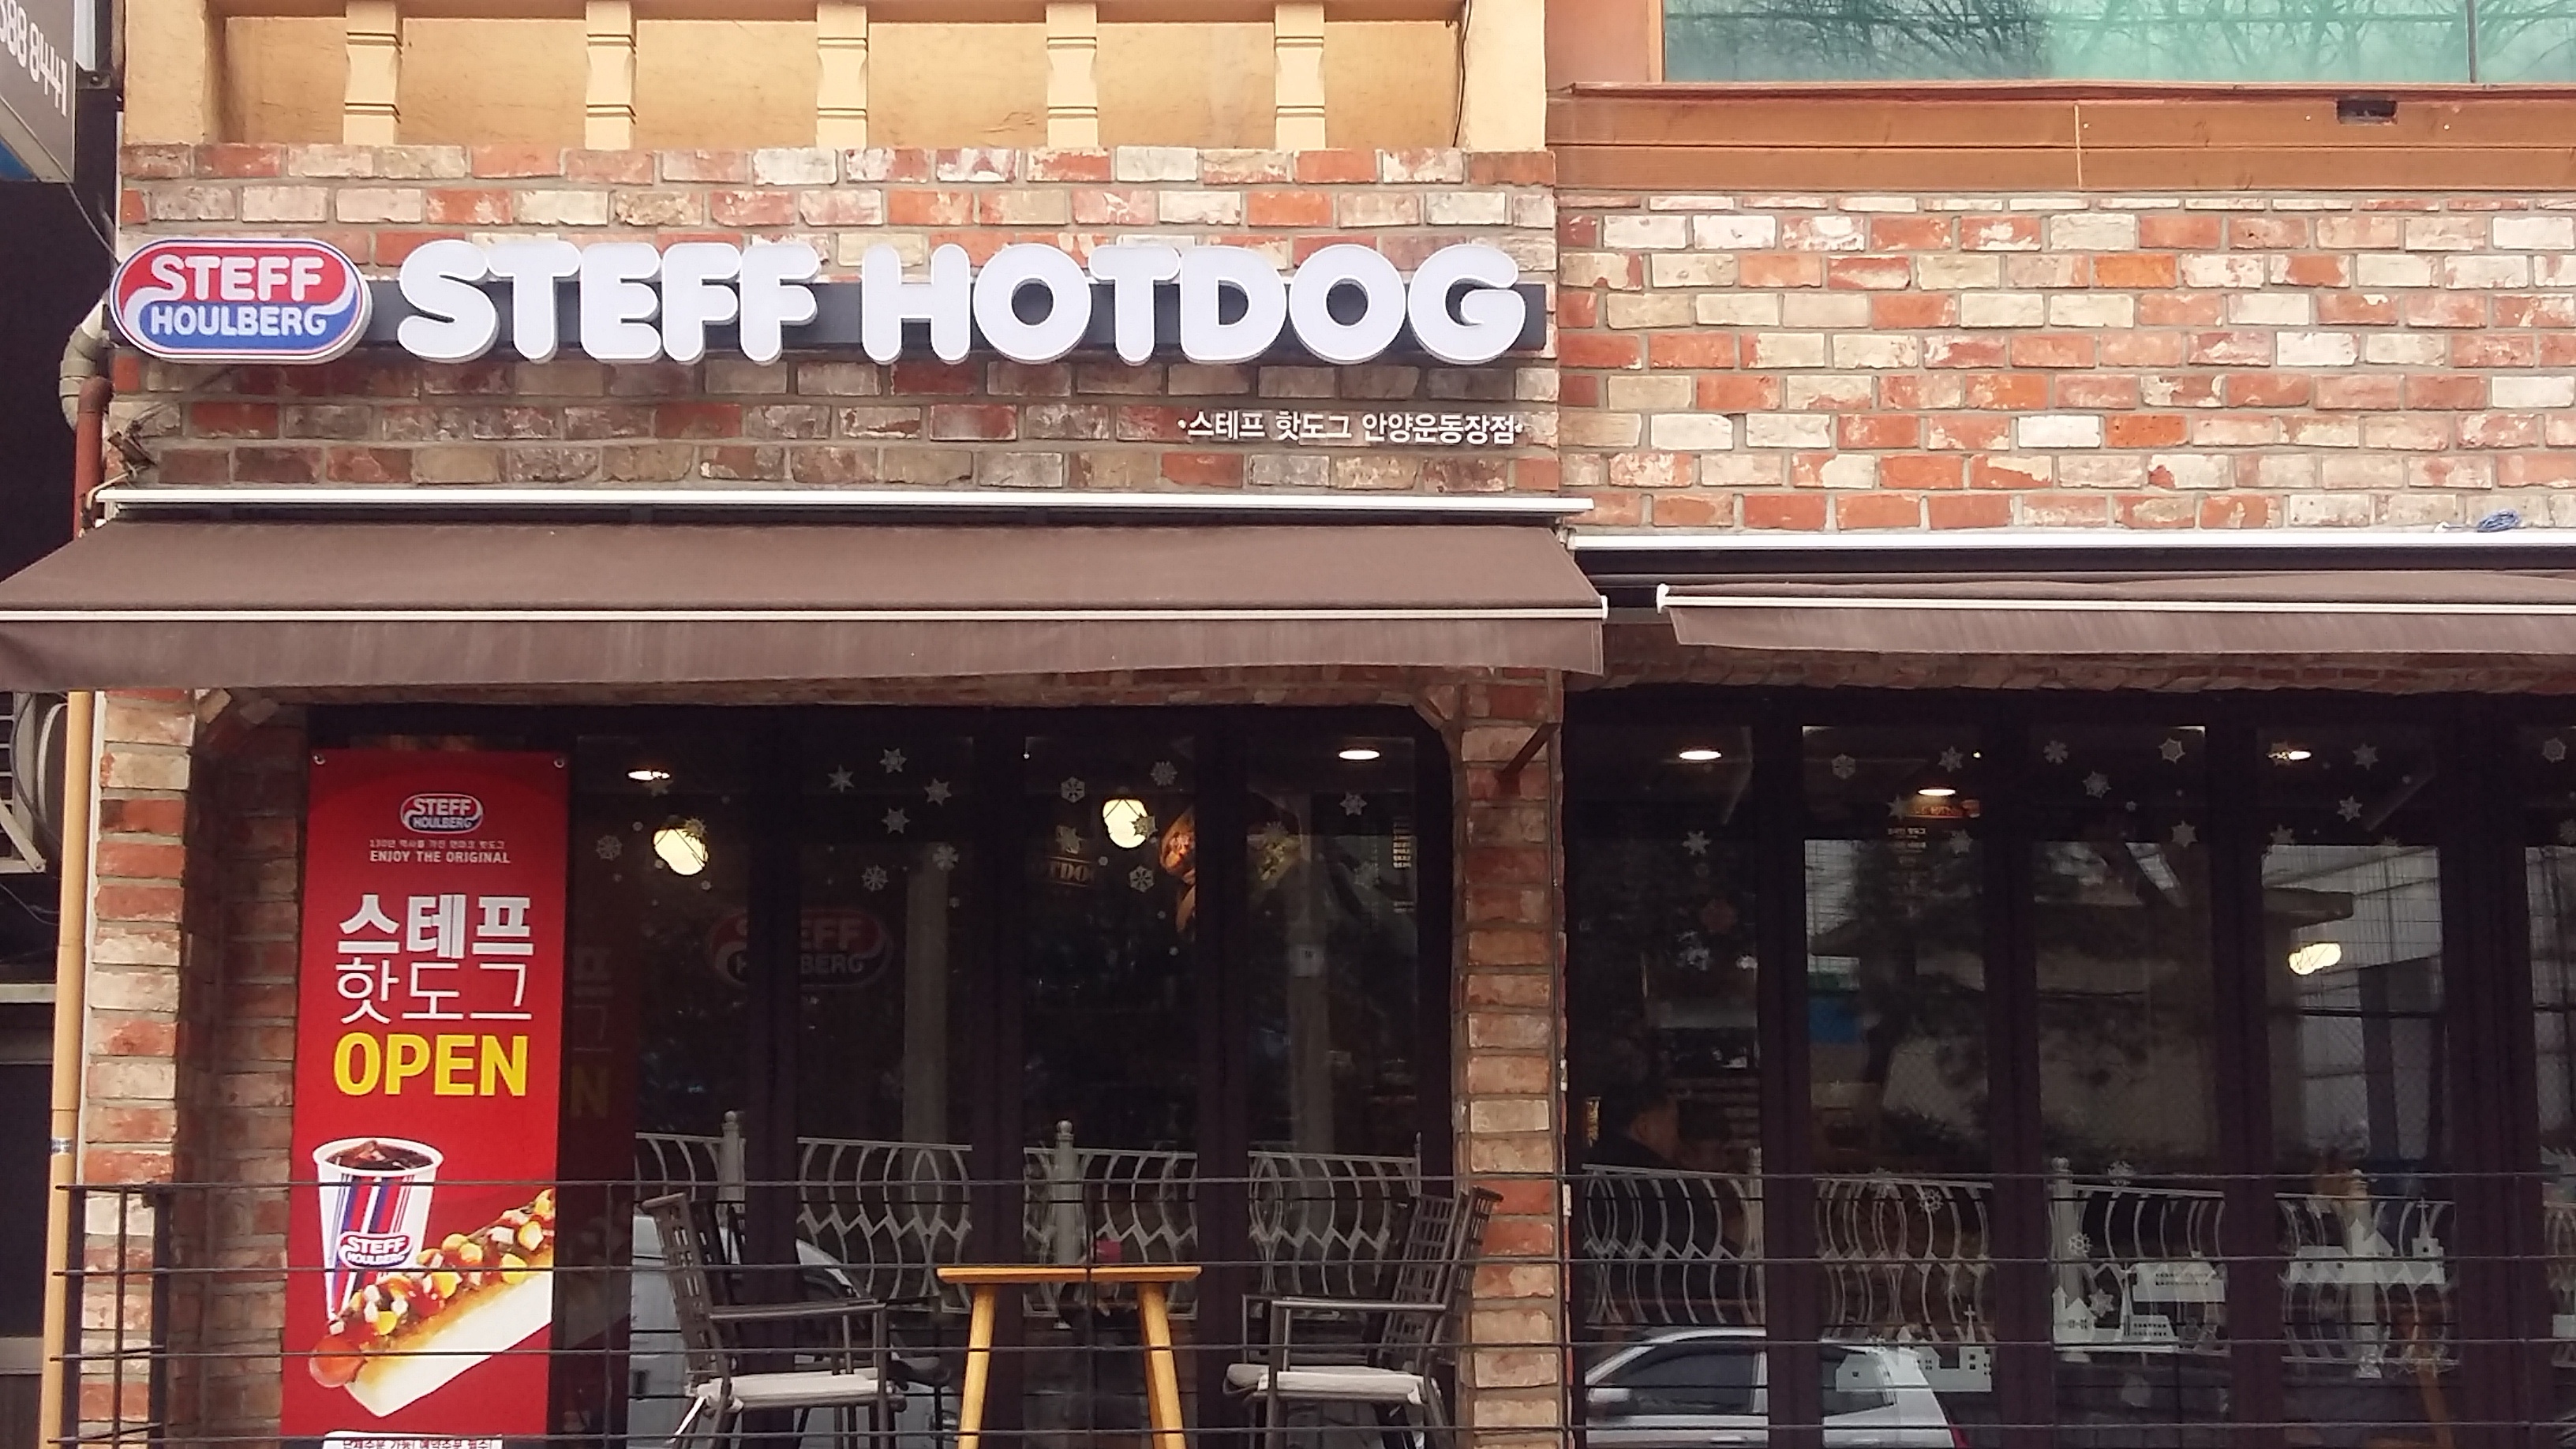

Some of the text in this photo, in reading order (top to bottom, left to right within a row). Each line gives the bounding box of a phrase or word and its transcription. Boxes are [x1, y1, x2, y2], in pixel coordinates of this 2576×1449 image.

[29, 22, 67, 117] 8441
[150, 253, 325, 302] STEFF
[150, 305, 328, 336] HOULBERG
[397, 239, 1527, 364] STEFF HOTDOG
[1187, 410, 1516, 444] 스테프 핫도그 안양운동장점
[412, 816, 473, 829] HOULBERG
[413, 798, 472, 816] STEFF
[369, 850, 511, 863] ENJOY THE ORIGINAL
[337, 893, 535, 959] 스테프
[335, 957, 534, 1024] 핫도그
[333, 1032, 529, 1097] OPEN
[347, 1236, 406, 1254] STEFF
